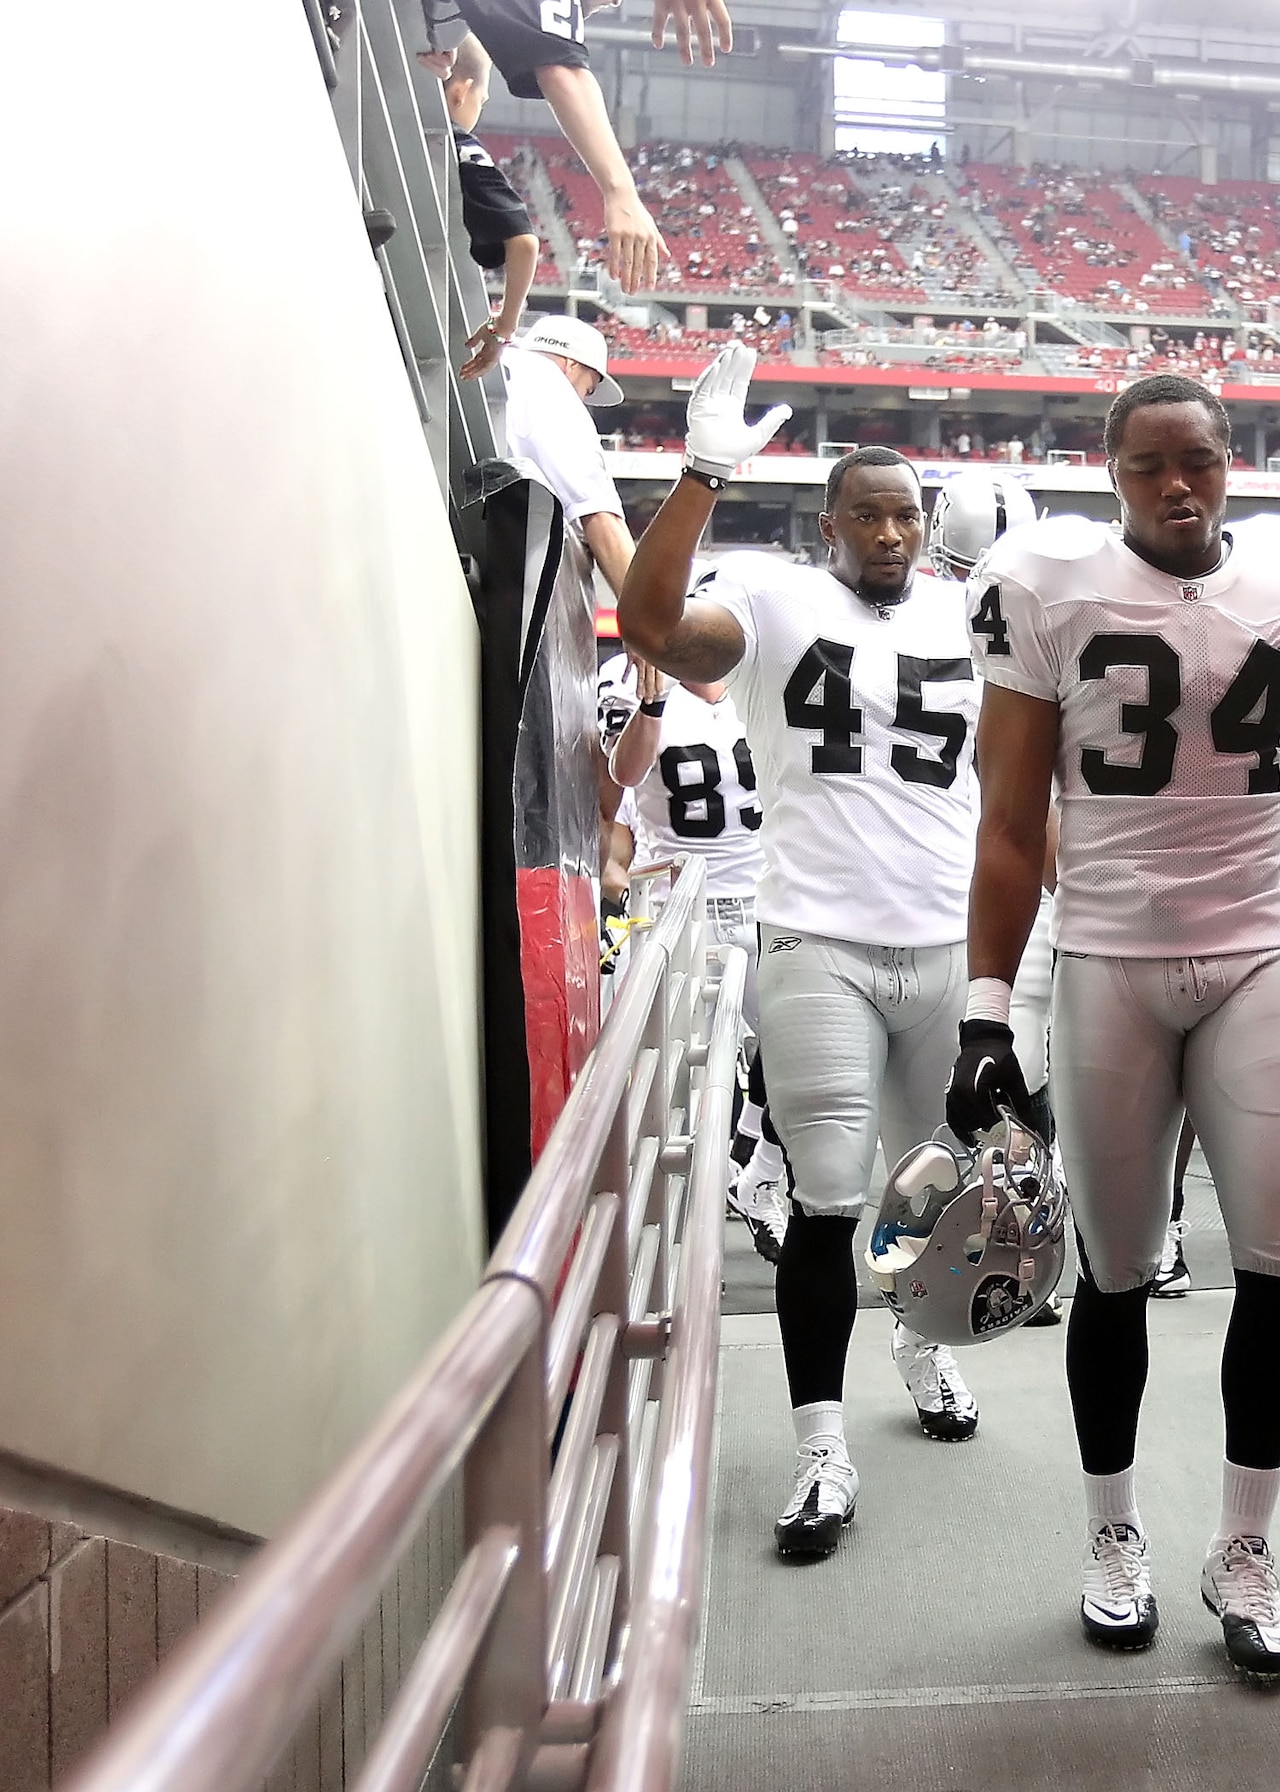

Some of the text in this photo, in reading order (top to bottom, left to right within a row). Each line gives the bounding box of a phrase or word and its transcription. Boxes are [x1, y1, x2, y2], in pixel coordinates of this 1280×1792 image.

[971, 583, 1011, 657] 4
[783, 635, 975, 790] 45
[980, 1304, 1028, 1332] RAIDERS
